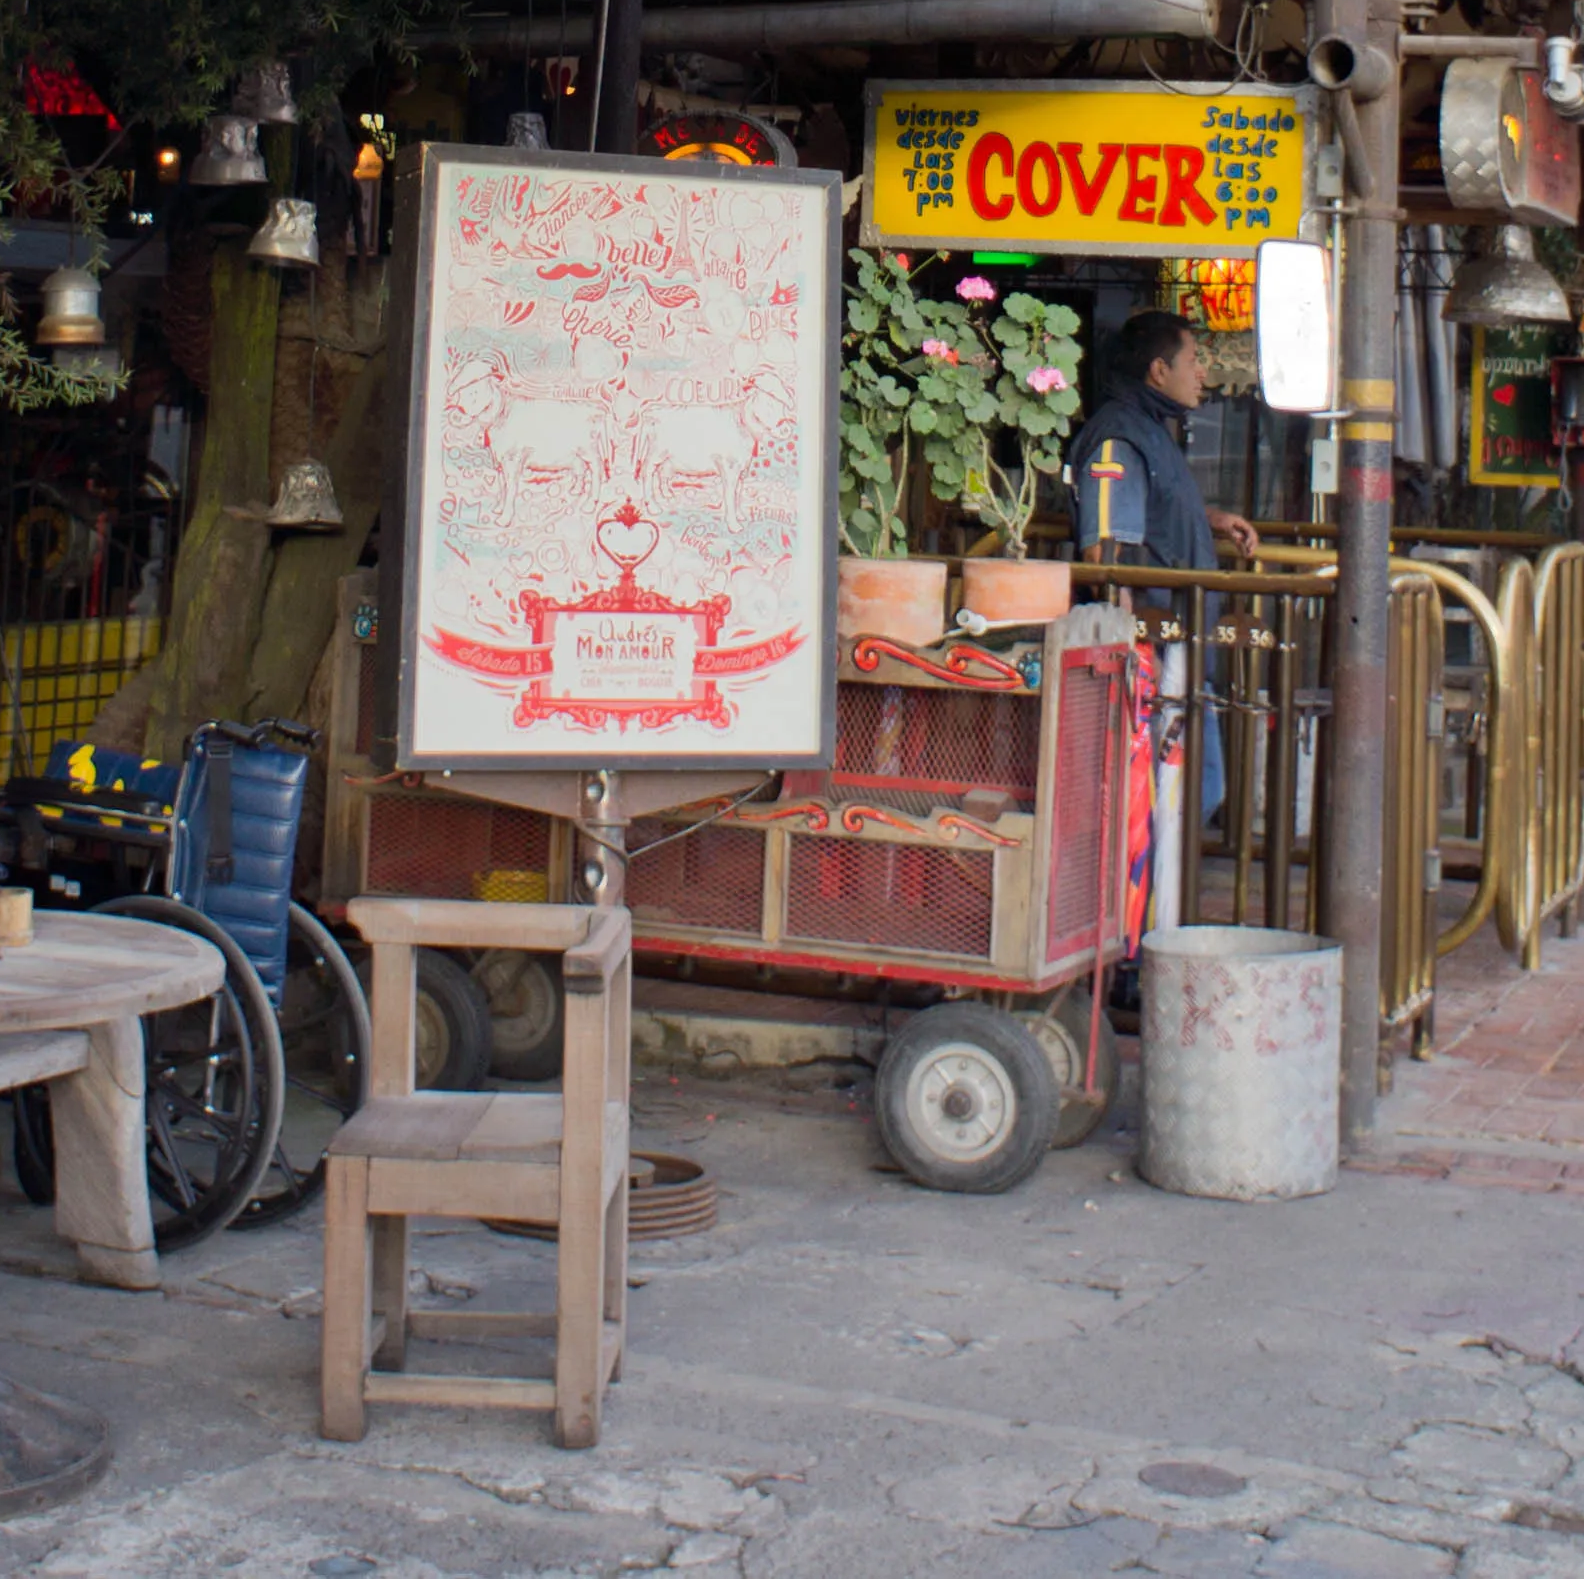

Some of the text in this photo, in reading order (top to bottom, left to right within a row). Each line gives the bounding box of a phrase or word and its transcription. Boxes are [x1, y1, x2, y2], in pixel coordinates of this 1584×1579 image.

[894, 104, 981, 127] viernes
[1201, 105, 1296, 132] Sabado
[897, 127, 965, 150] desde
[1206, 133, 1278, 159] desde
[903, 170, 954, 191] 7:00
[966, 131, 1217, 227] COVER
[916, 191, 954, 216] pm
[1216, 181, 1278, 204] 6:00
[1226, 207, 1271, 231] pm
[525, 652, 543, 673] 15
